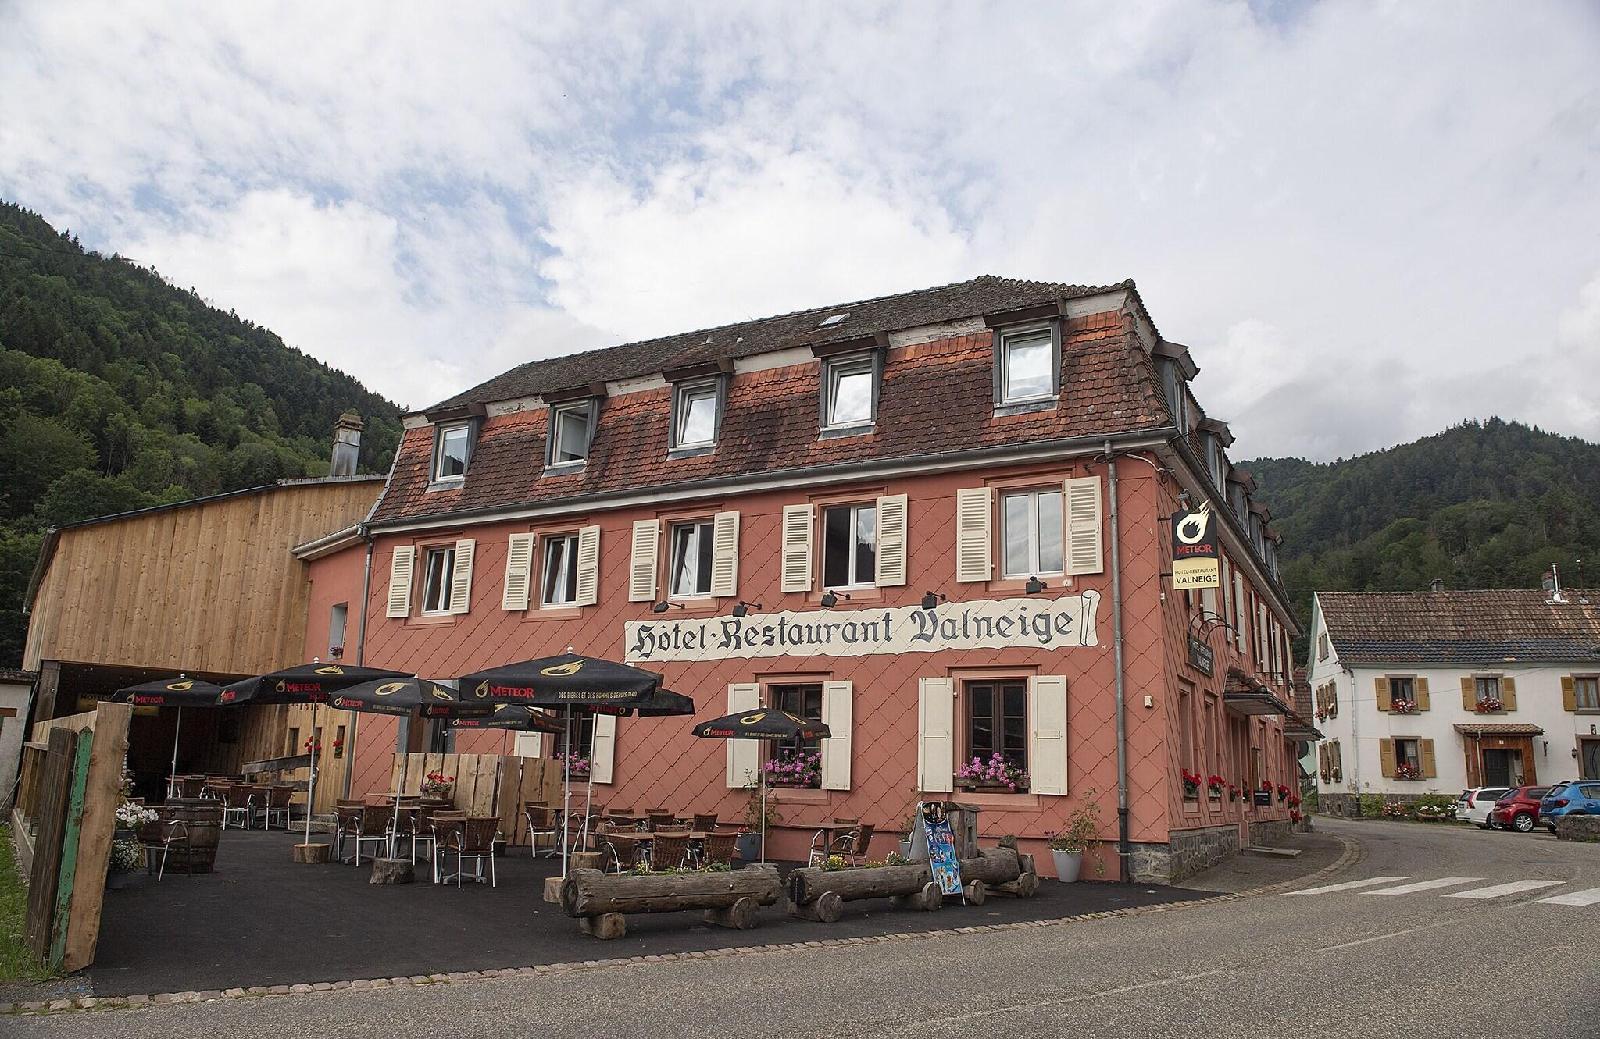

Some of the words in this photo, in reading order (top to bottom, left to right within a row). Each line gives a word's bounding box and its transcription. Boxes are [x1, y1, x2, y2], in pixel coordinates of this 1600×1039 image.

[1176, 544, 1213, 554] METEOR
[1176, 575, 1217, 584] VALNEIGE
[910, 606, 1074, 645] Valneige
[489, 685, 535, 698] METEOR
[134, 695, 166, 704] METEOR
